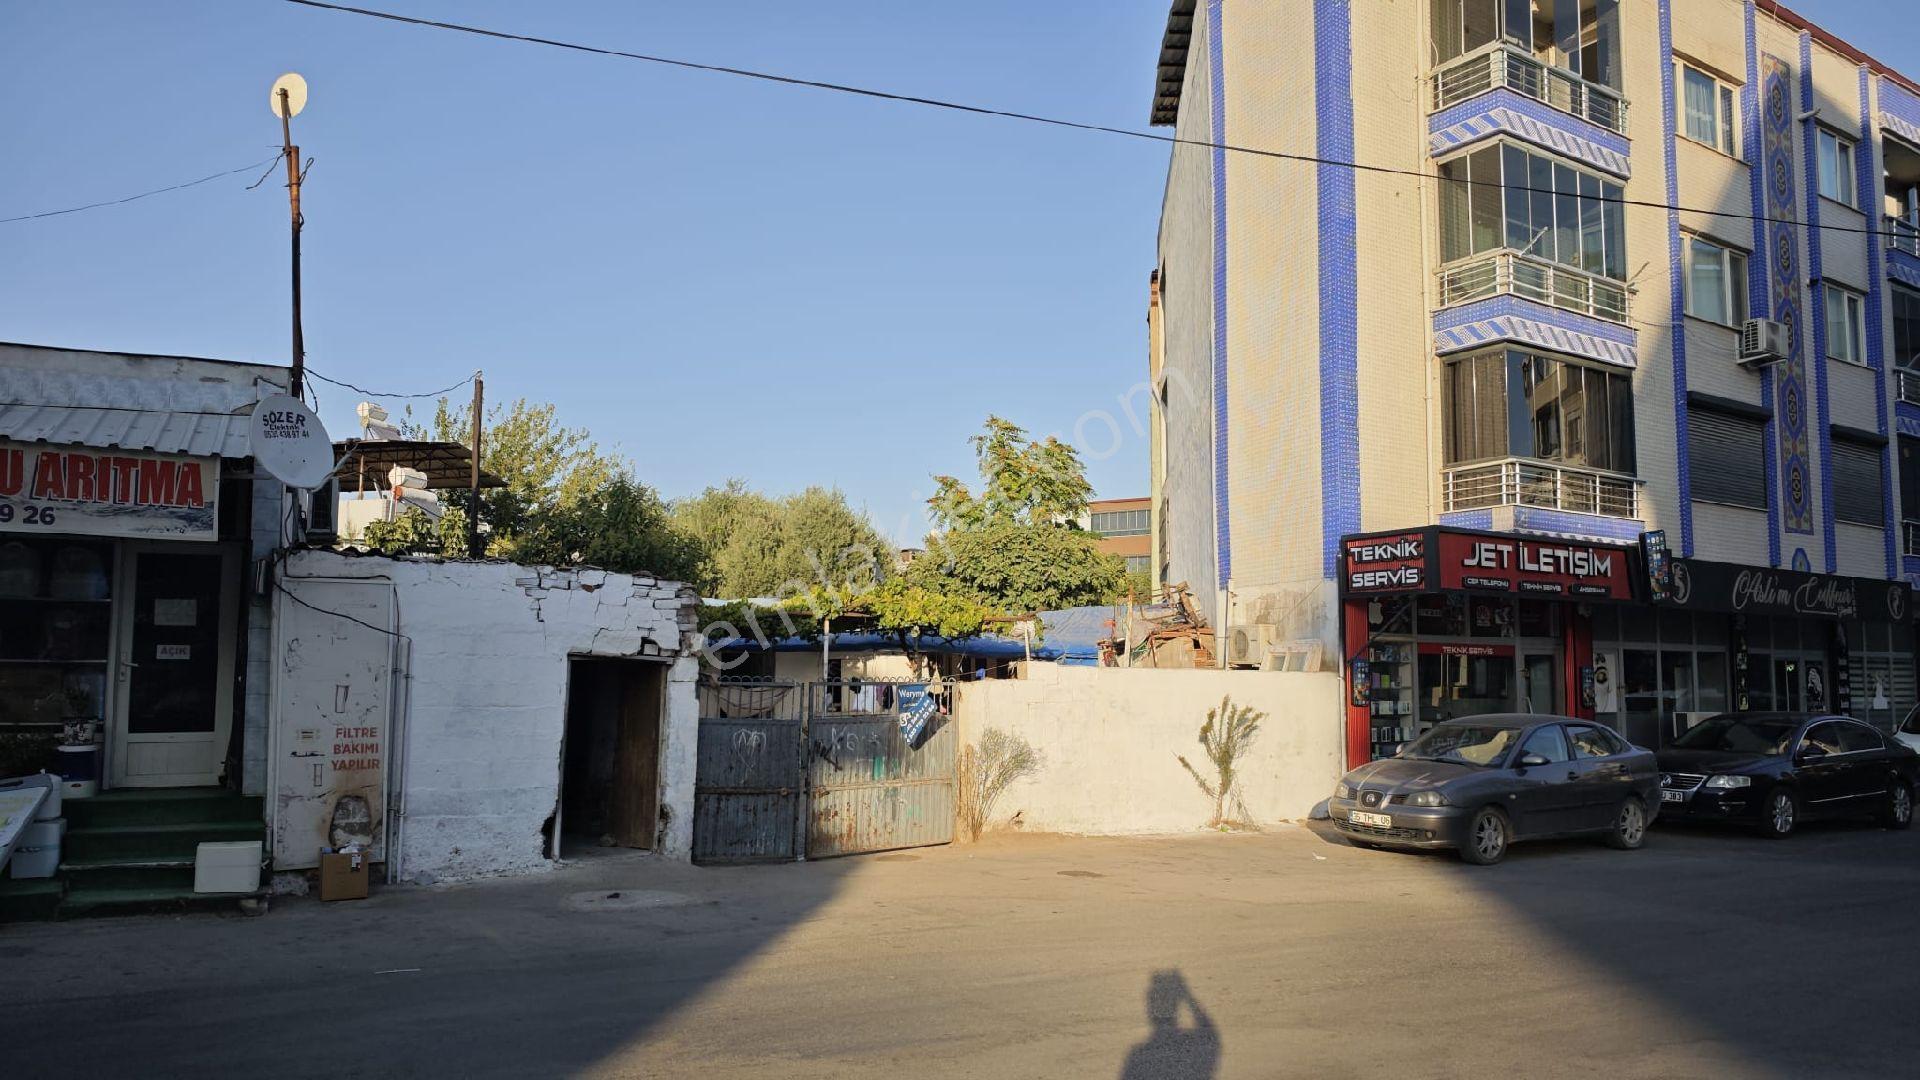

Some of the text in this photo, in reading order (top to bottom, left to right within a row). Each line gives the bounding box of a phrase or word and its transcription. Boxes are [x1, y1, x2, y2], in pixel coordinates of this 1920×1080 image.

[33, 450, 205, 510] ARITMA
[22, 505, 56, 526] 26
[1350, 539, 1418, 562] TEKNİK
[1463, 541, 1611, 579] JET İLETİŞİM
[1352, 566, 1419, 588] SERVİS
[333, 743, 379, 755] BAKIMI
